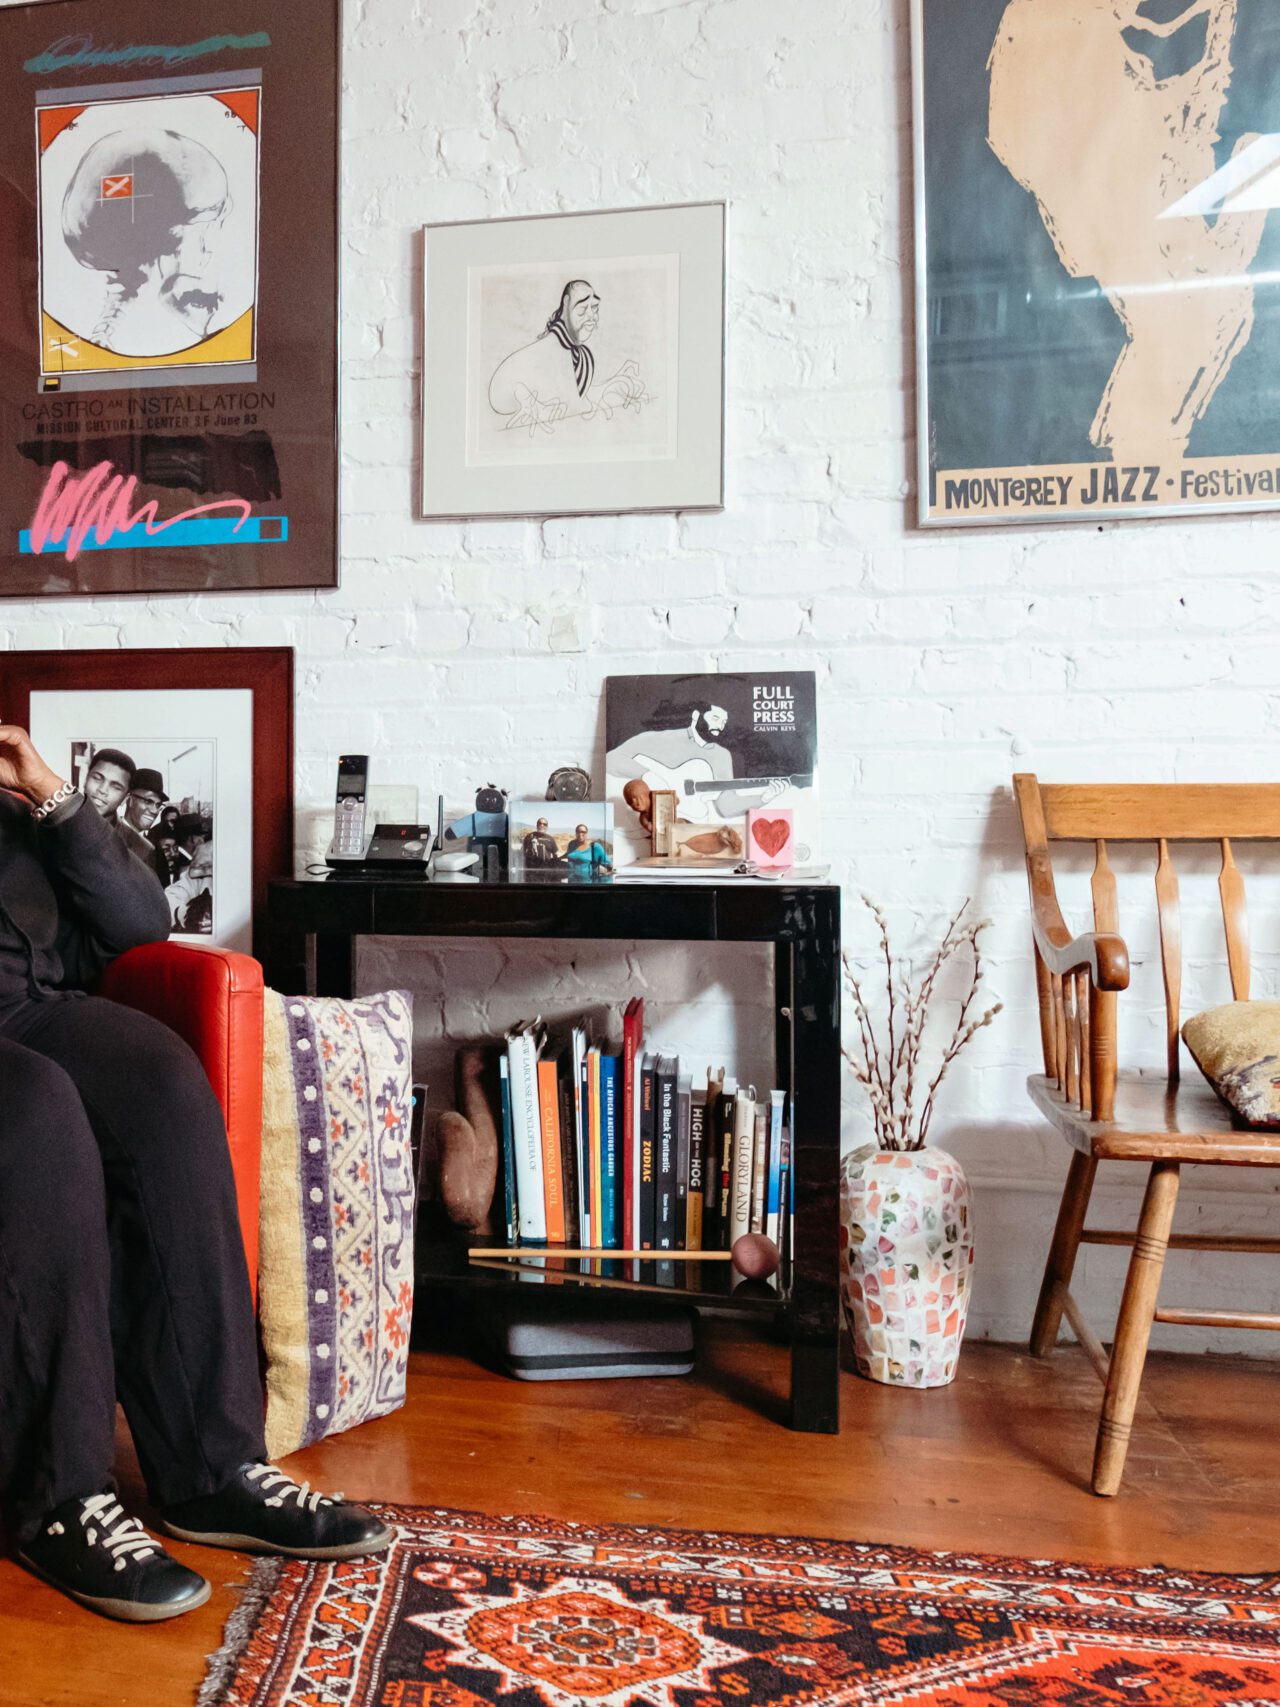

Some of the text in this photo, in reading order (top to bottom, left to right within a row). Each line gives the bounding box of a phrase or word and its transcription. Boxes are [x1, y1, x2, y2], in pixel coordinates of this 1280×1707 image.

[22, 399, 104, 420] CASTRO
[128, 392, 276, 415] INSTALLATION
[36, 421, 81, 435] MISSION
[85, 419, 144, 433] CULTURAL
[147, 416, 189, 430] CENTER
[213, 414, 241, 427] June
[753, 686, 794, 700] FULL
[753, 700, 794, 710] COURT
[753, 711, 795, 723] PRESS
[663, 1083, 672, 1091] In
[663, 1093, 671, 1107] the
[524, 1099, 536, 1160] ENCYCLOPEDIA
[662, 1109, 672, 1132] Black
[692, 1108, 703, 1140] HIGH
[544, 1107, 558, 1207] CALIFORNIA SOUL
[607, 1152, 615, 1177] GARDEN
[642, 1140, 651, 1182] ZODIAC
[662, 1133, 671, 1173] Fantastic
[529, 1160, 537, 1172] OF
[690, 1159, 701, 1187] HOG
[736, 1135, 749, 1222] GLORYLAND
